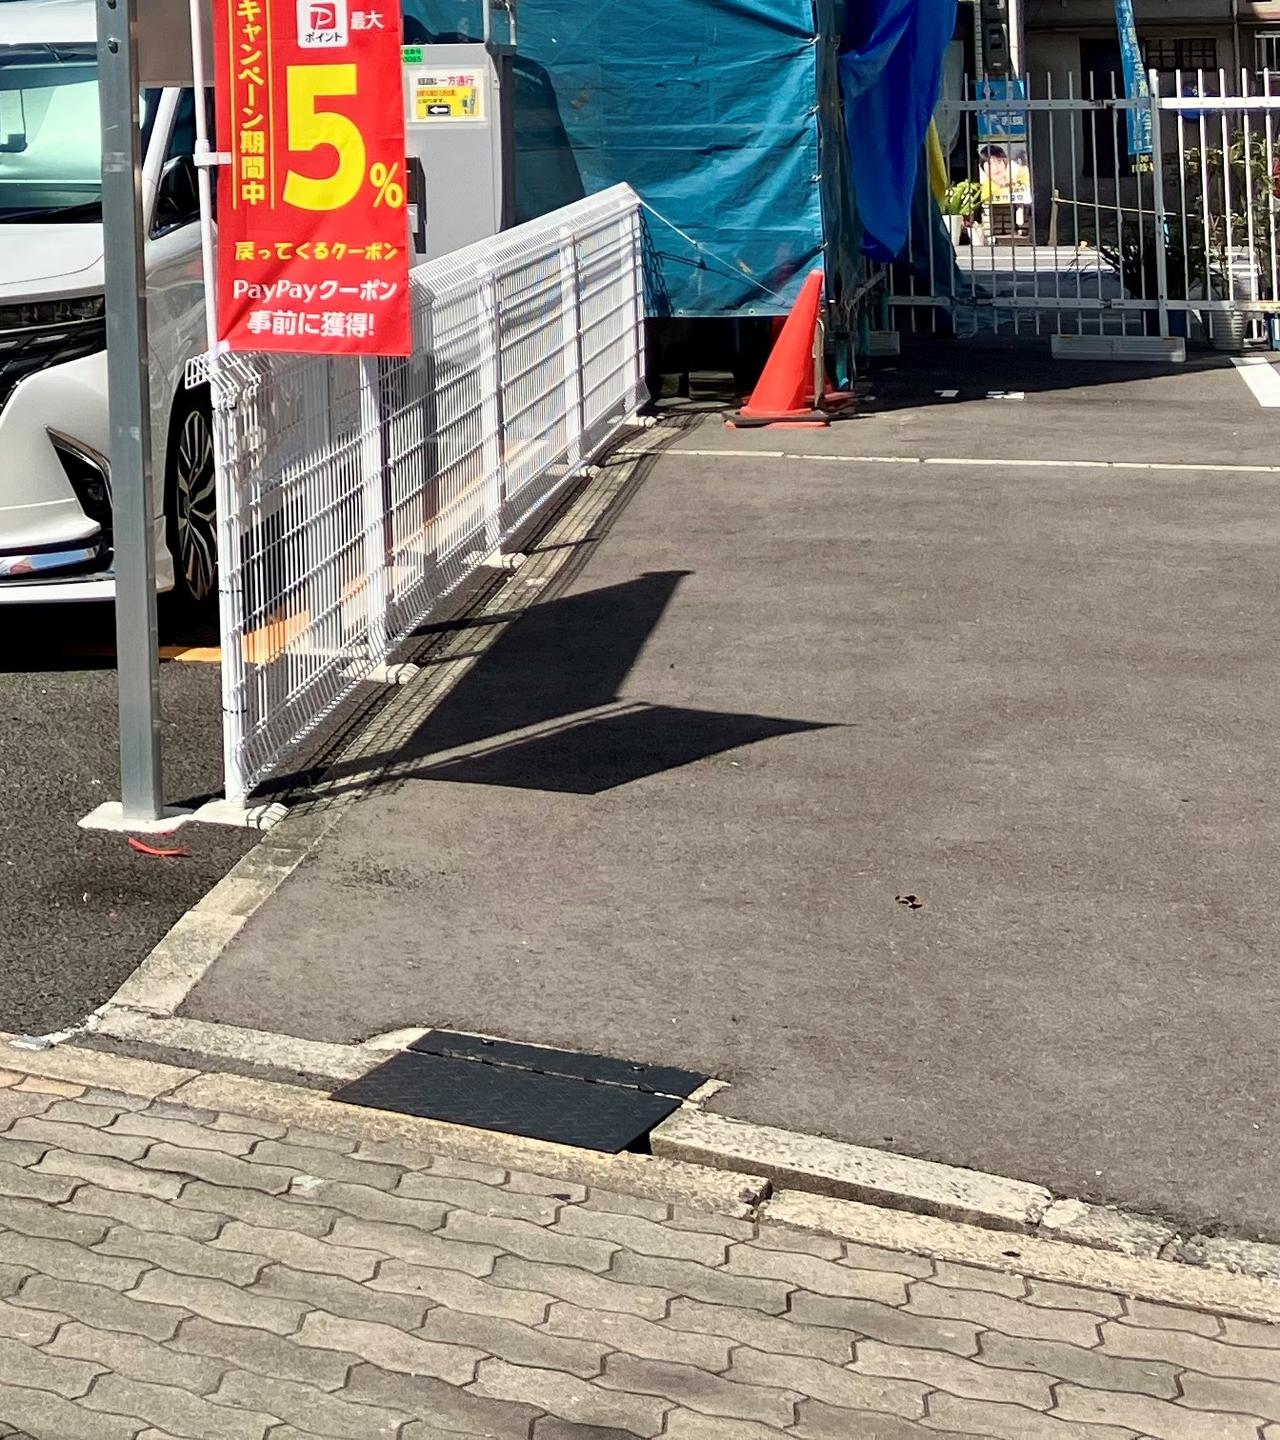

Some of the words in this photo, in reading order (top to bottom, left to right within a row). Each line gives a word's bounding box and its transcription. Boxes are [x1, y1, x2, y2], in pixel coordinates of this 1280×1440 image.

[350, 10, 384, 30] 最大
[304, 31, 343, 44] ポイント
[235, 241, 398, 261] 戻ってくるクーポン
[233, 279, 398, 304] PayPayクーポン
[246, 310, 375, 338] 事前に獲得!
